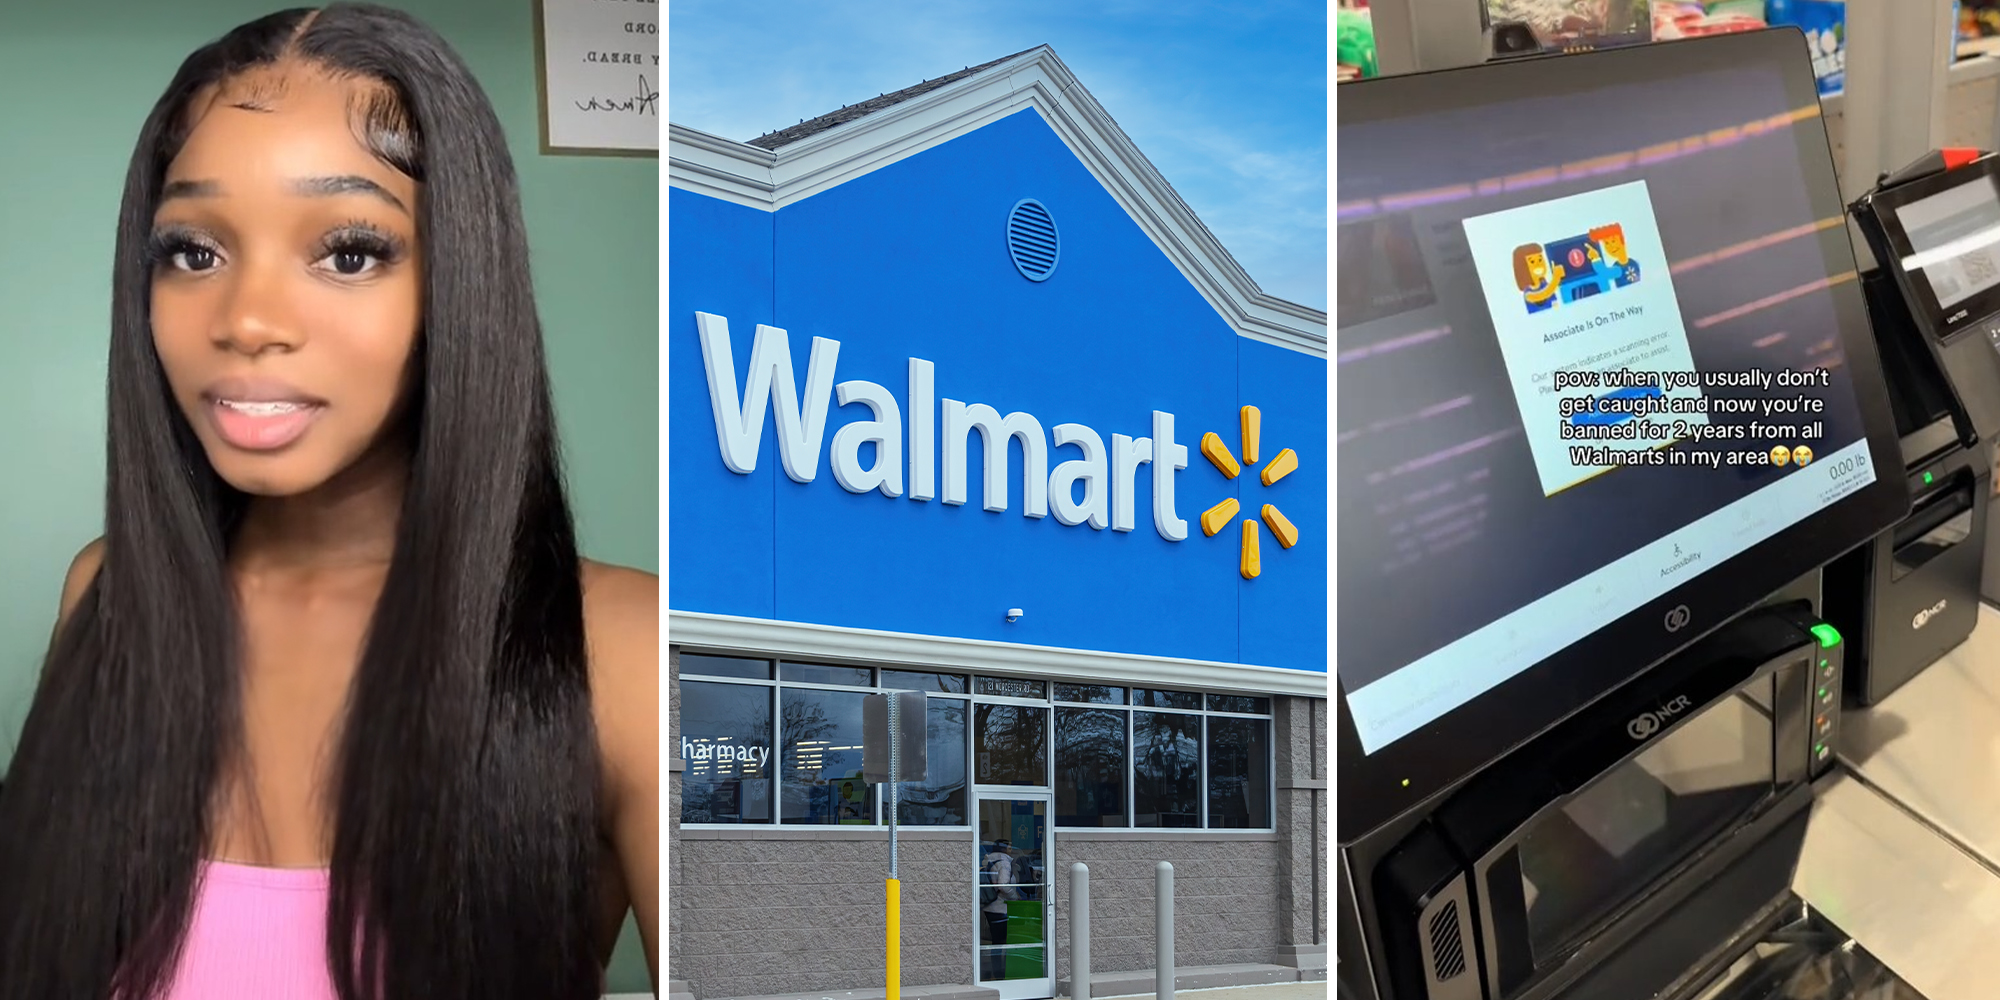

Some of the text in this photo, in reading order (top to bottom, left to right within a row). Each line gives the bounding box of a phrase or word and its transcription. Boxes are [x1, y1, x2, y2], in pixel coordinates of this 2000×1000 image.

[1543, 305, 1644, 343] Associate Is On The Way
[1578, 352, 1612, 368] indicates
[1619, 338, 1650, 353] scanning
[1650, 330, 1670, 343] error.
[1641, 351, 1650, 361] to
[695, 311, 1188, 542] Walmart
[1829, 453, 1866, 480] 0.00 lb
[1660, 551, 1701, 578] Accessibility
[1929, 598, 1947, 617] NCR
[1655, 694, 1692, 721] NCR
[681, 735, 770, 768] harmacy
